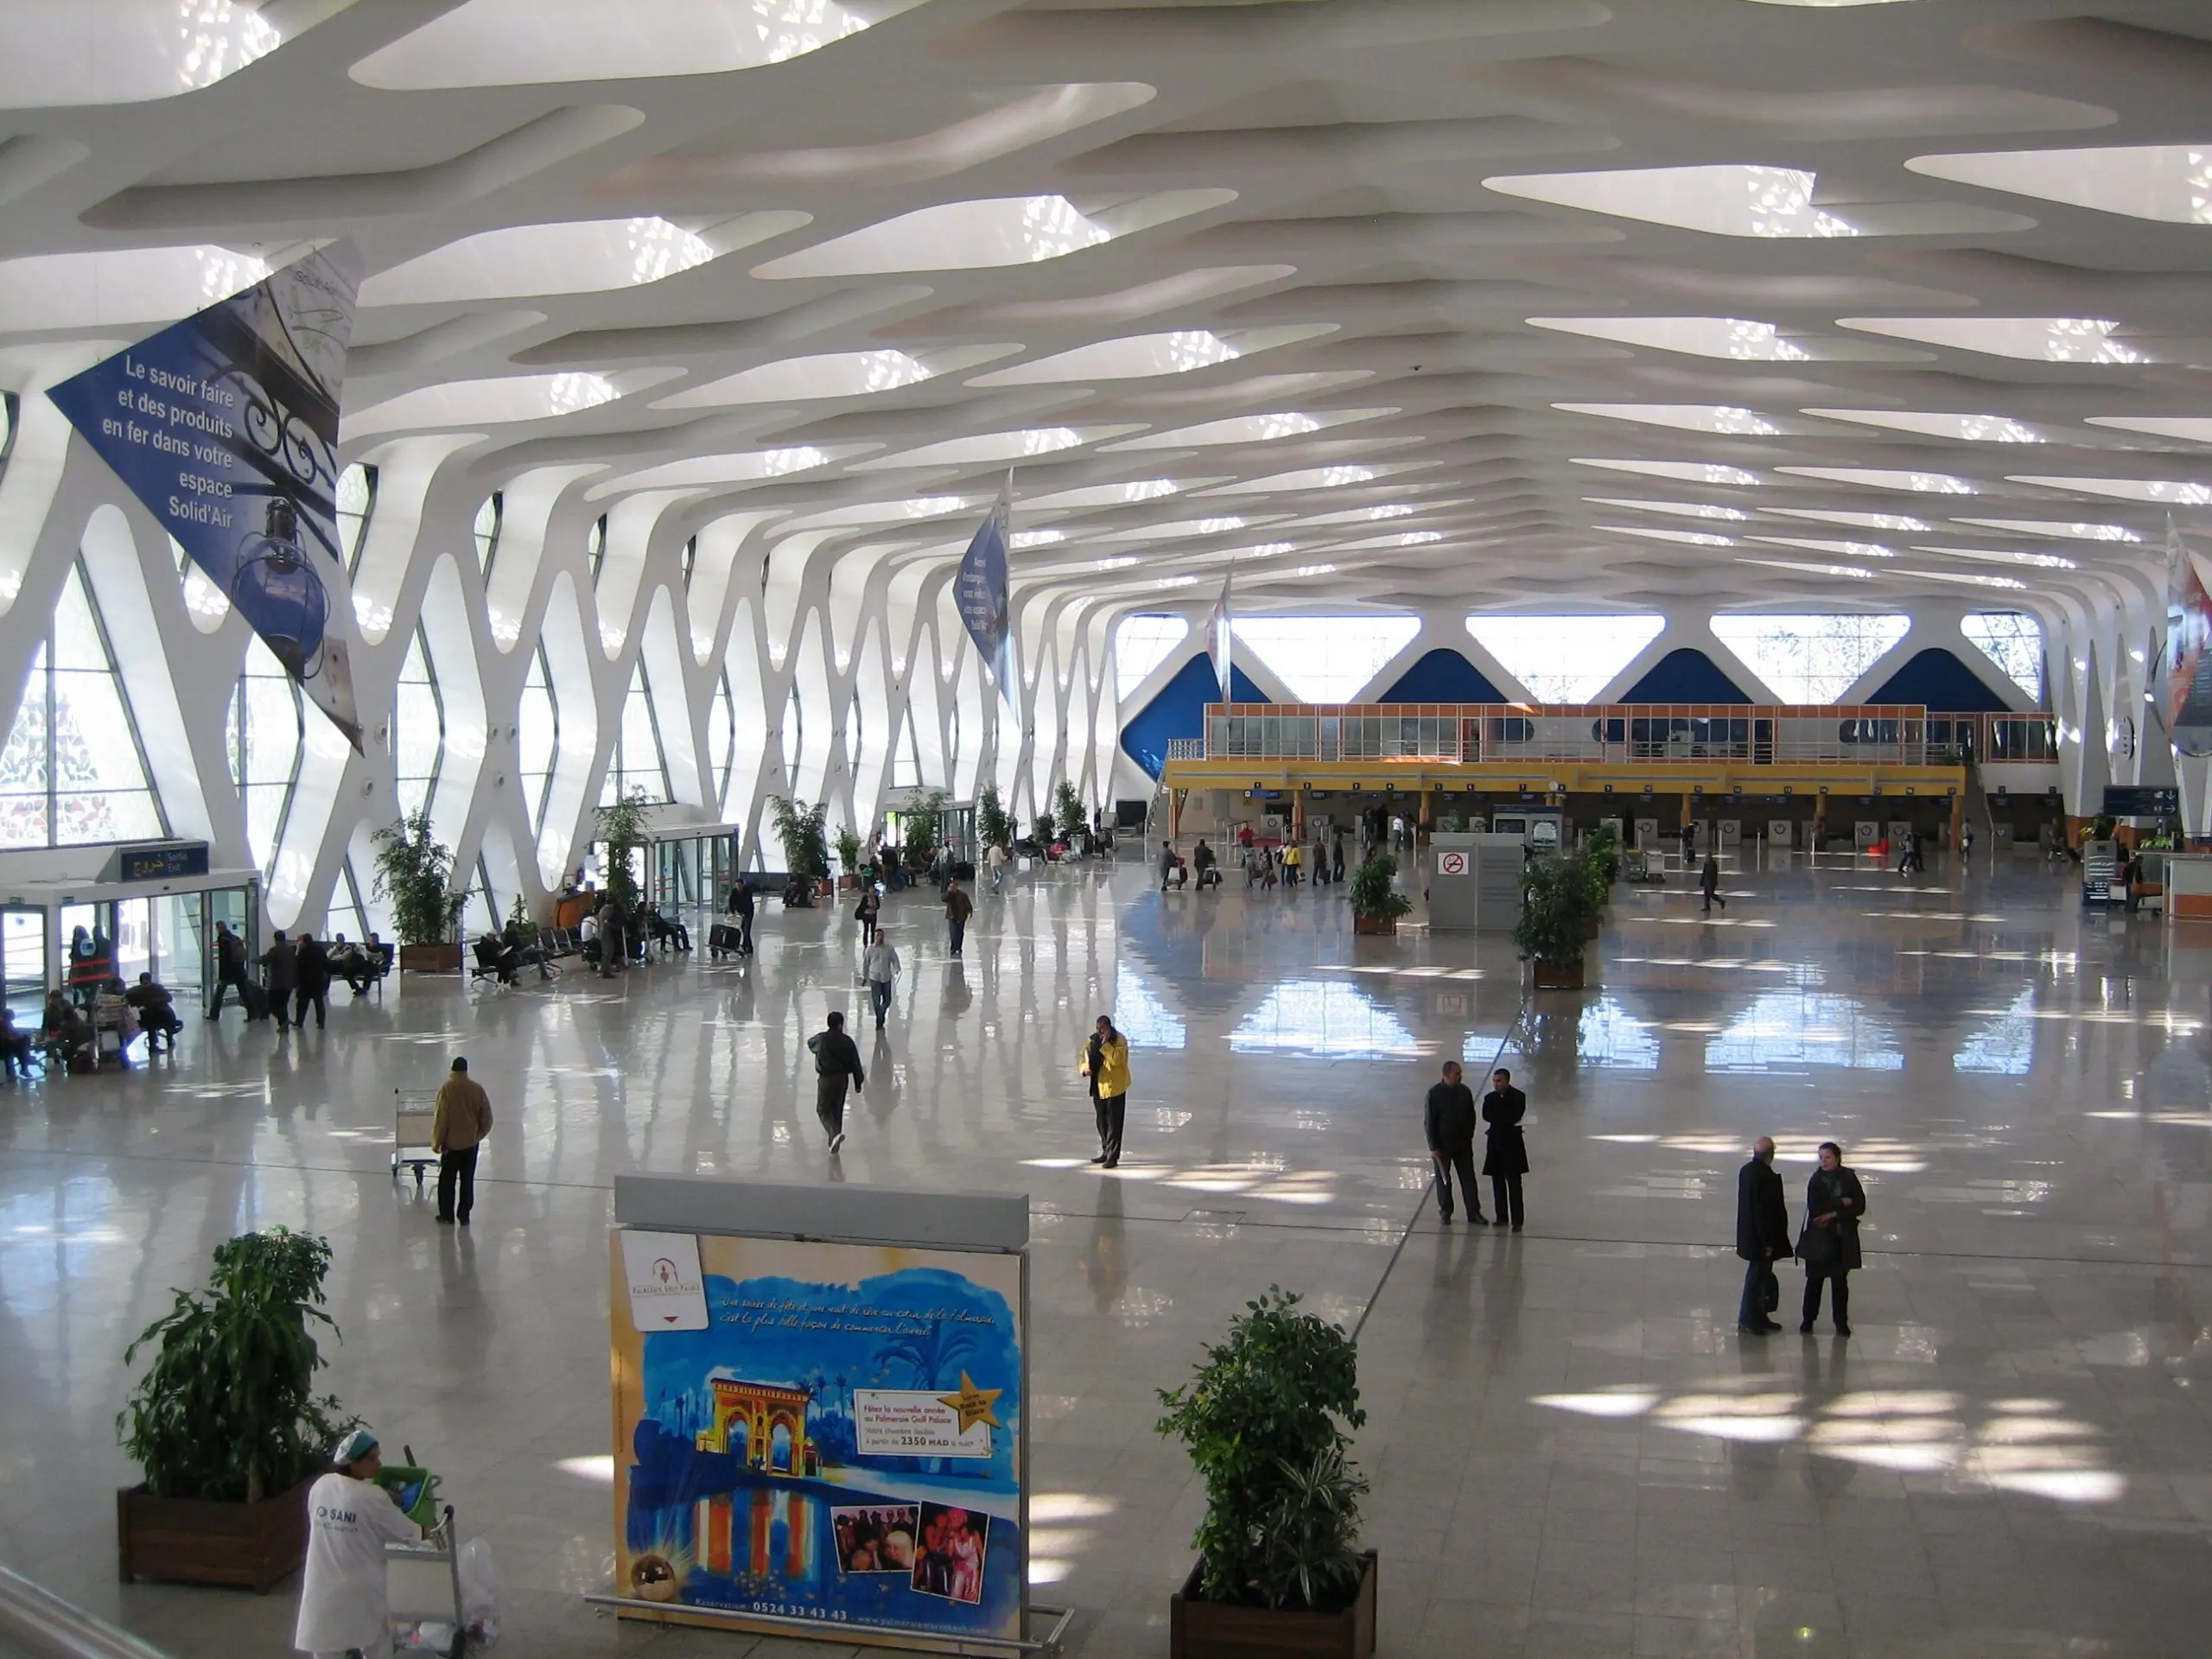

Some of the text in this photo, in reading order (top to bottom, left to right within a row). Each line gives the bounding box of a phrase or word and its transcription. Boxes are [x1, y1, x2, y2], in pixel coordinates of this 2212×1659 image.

[126, 354, 234, 408] Le savoir faire
[118, 389, 233, 438] et des produits
[102, 417, 232, 468] en fer dans votre
[179, 472, 233, 499] espace
[168, 495, 233, 529] Solid'Air
[900, 1435, 927, 1446] 2350
[330, 1508, 356, 1523] SANI
[753, 1601, 785, 1615] 0524
[790, 1605, 805, 1616] 33
[810, 1606, 826, 1618] 43
[831, 1610, 848, 1622] 43
